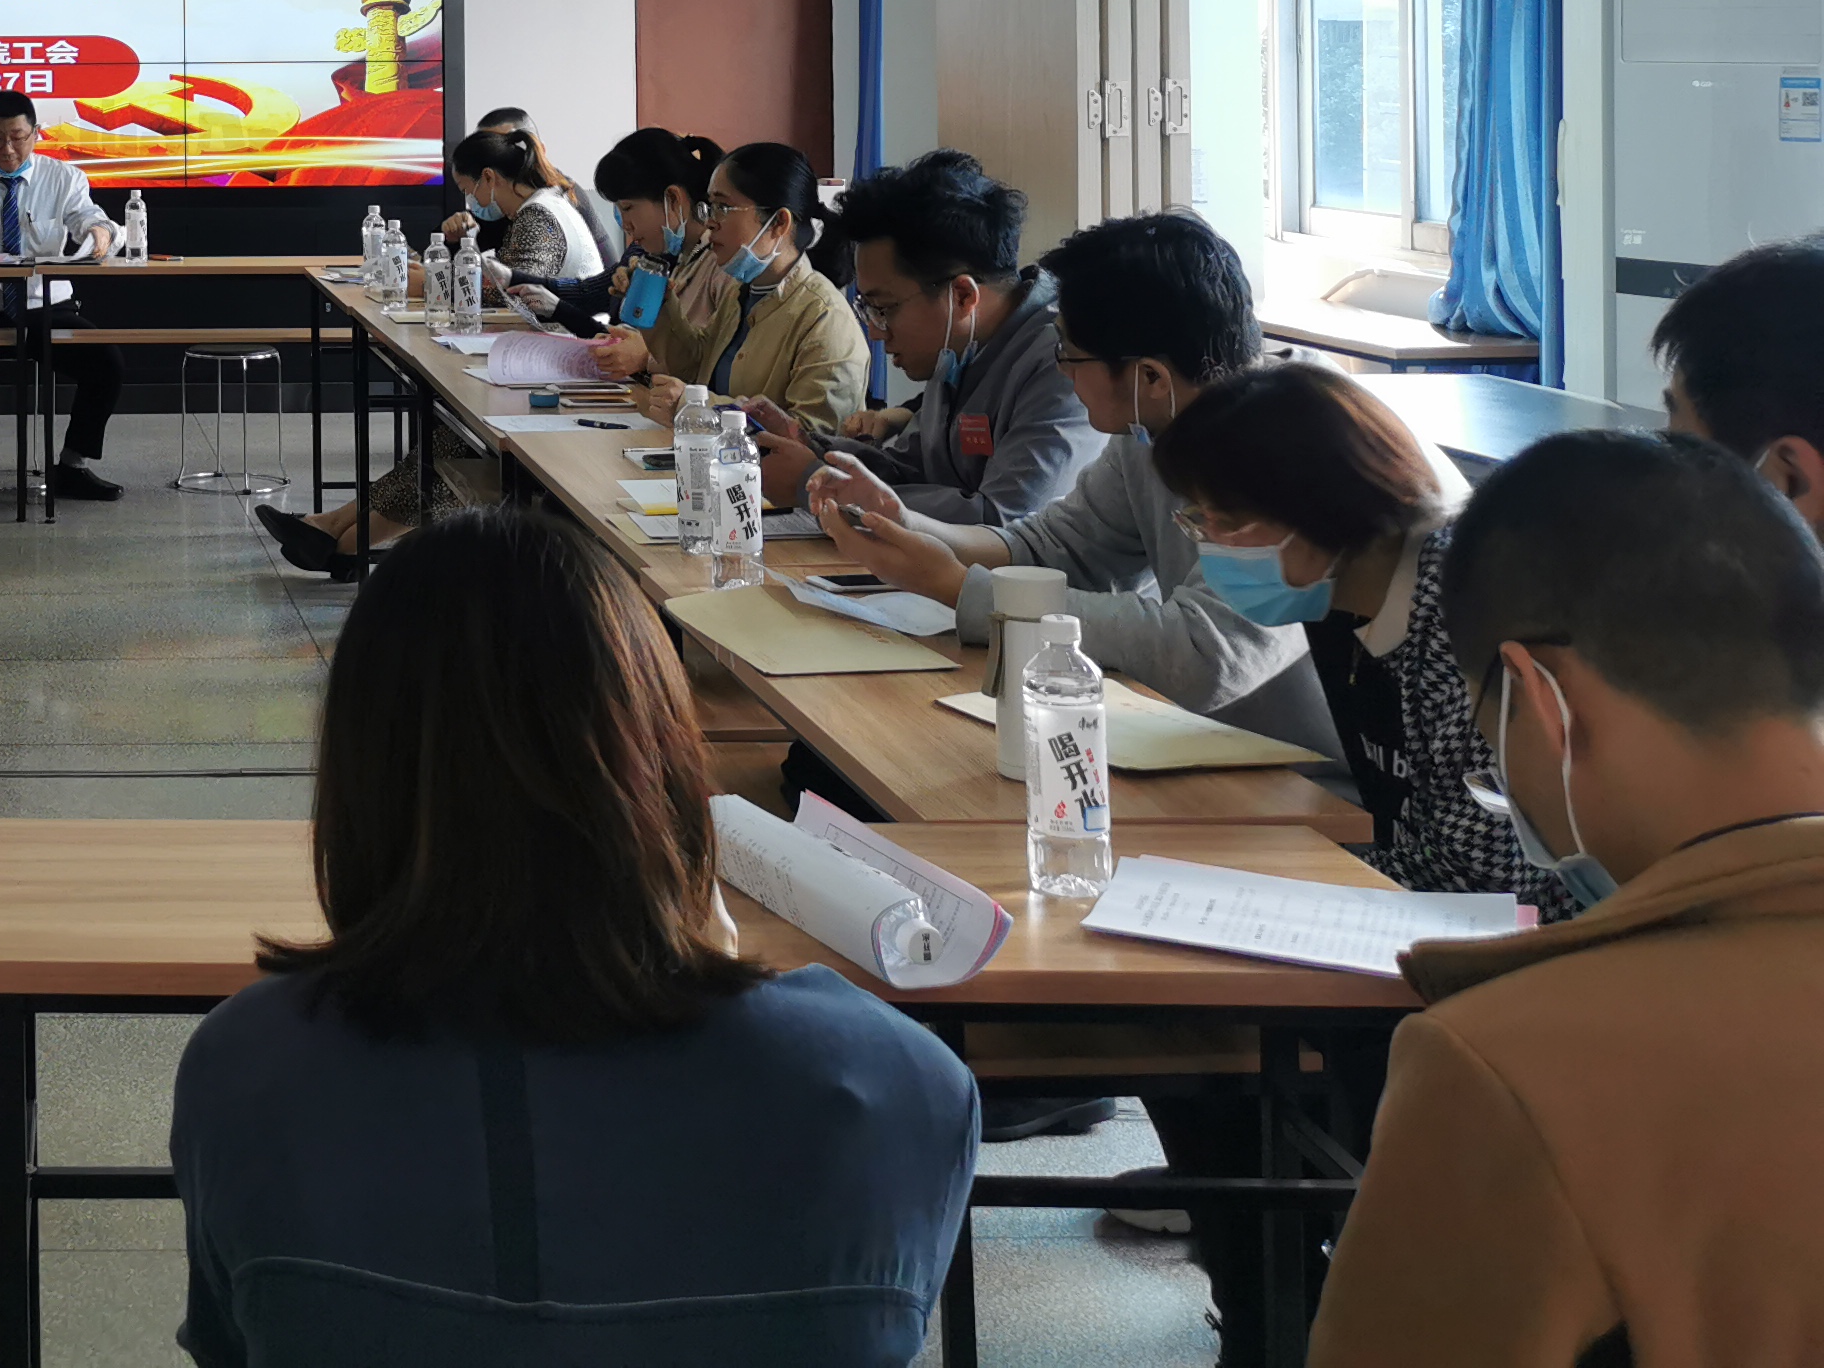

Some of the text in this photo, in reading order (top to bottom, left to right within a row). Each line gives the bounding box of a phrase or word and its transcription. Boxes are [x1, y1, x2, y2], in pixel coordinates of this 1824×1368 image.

[726, 483, 758, 541] 喝开水
[1047, 731, 1100, 819] 喝开水
